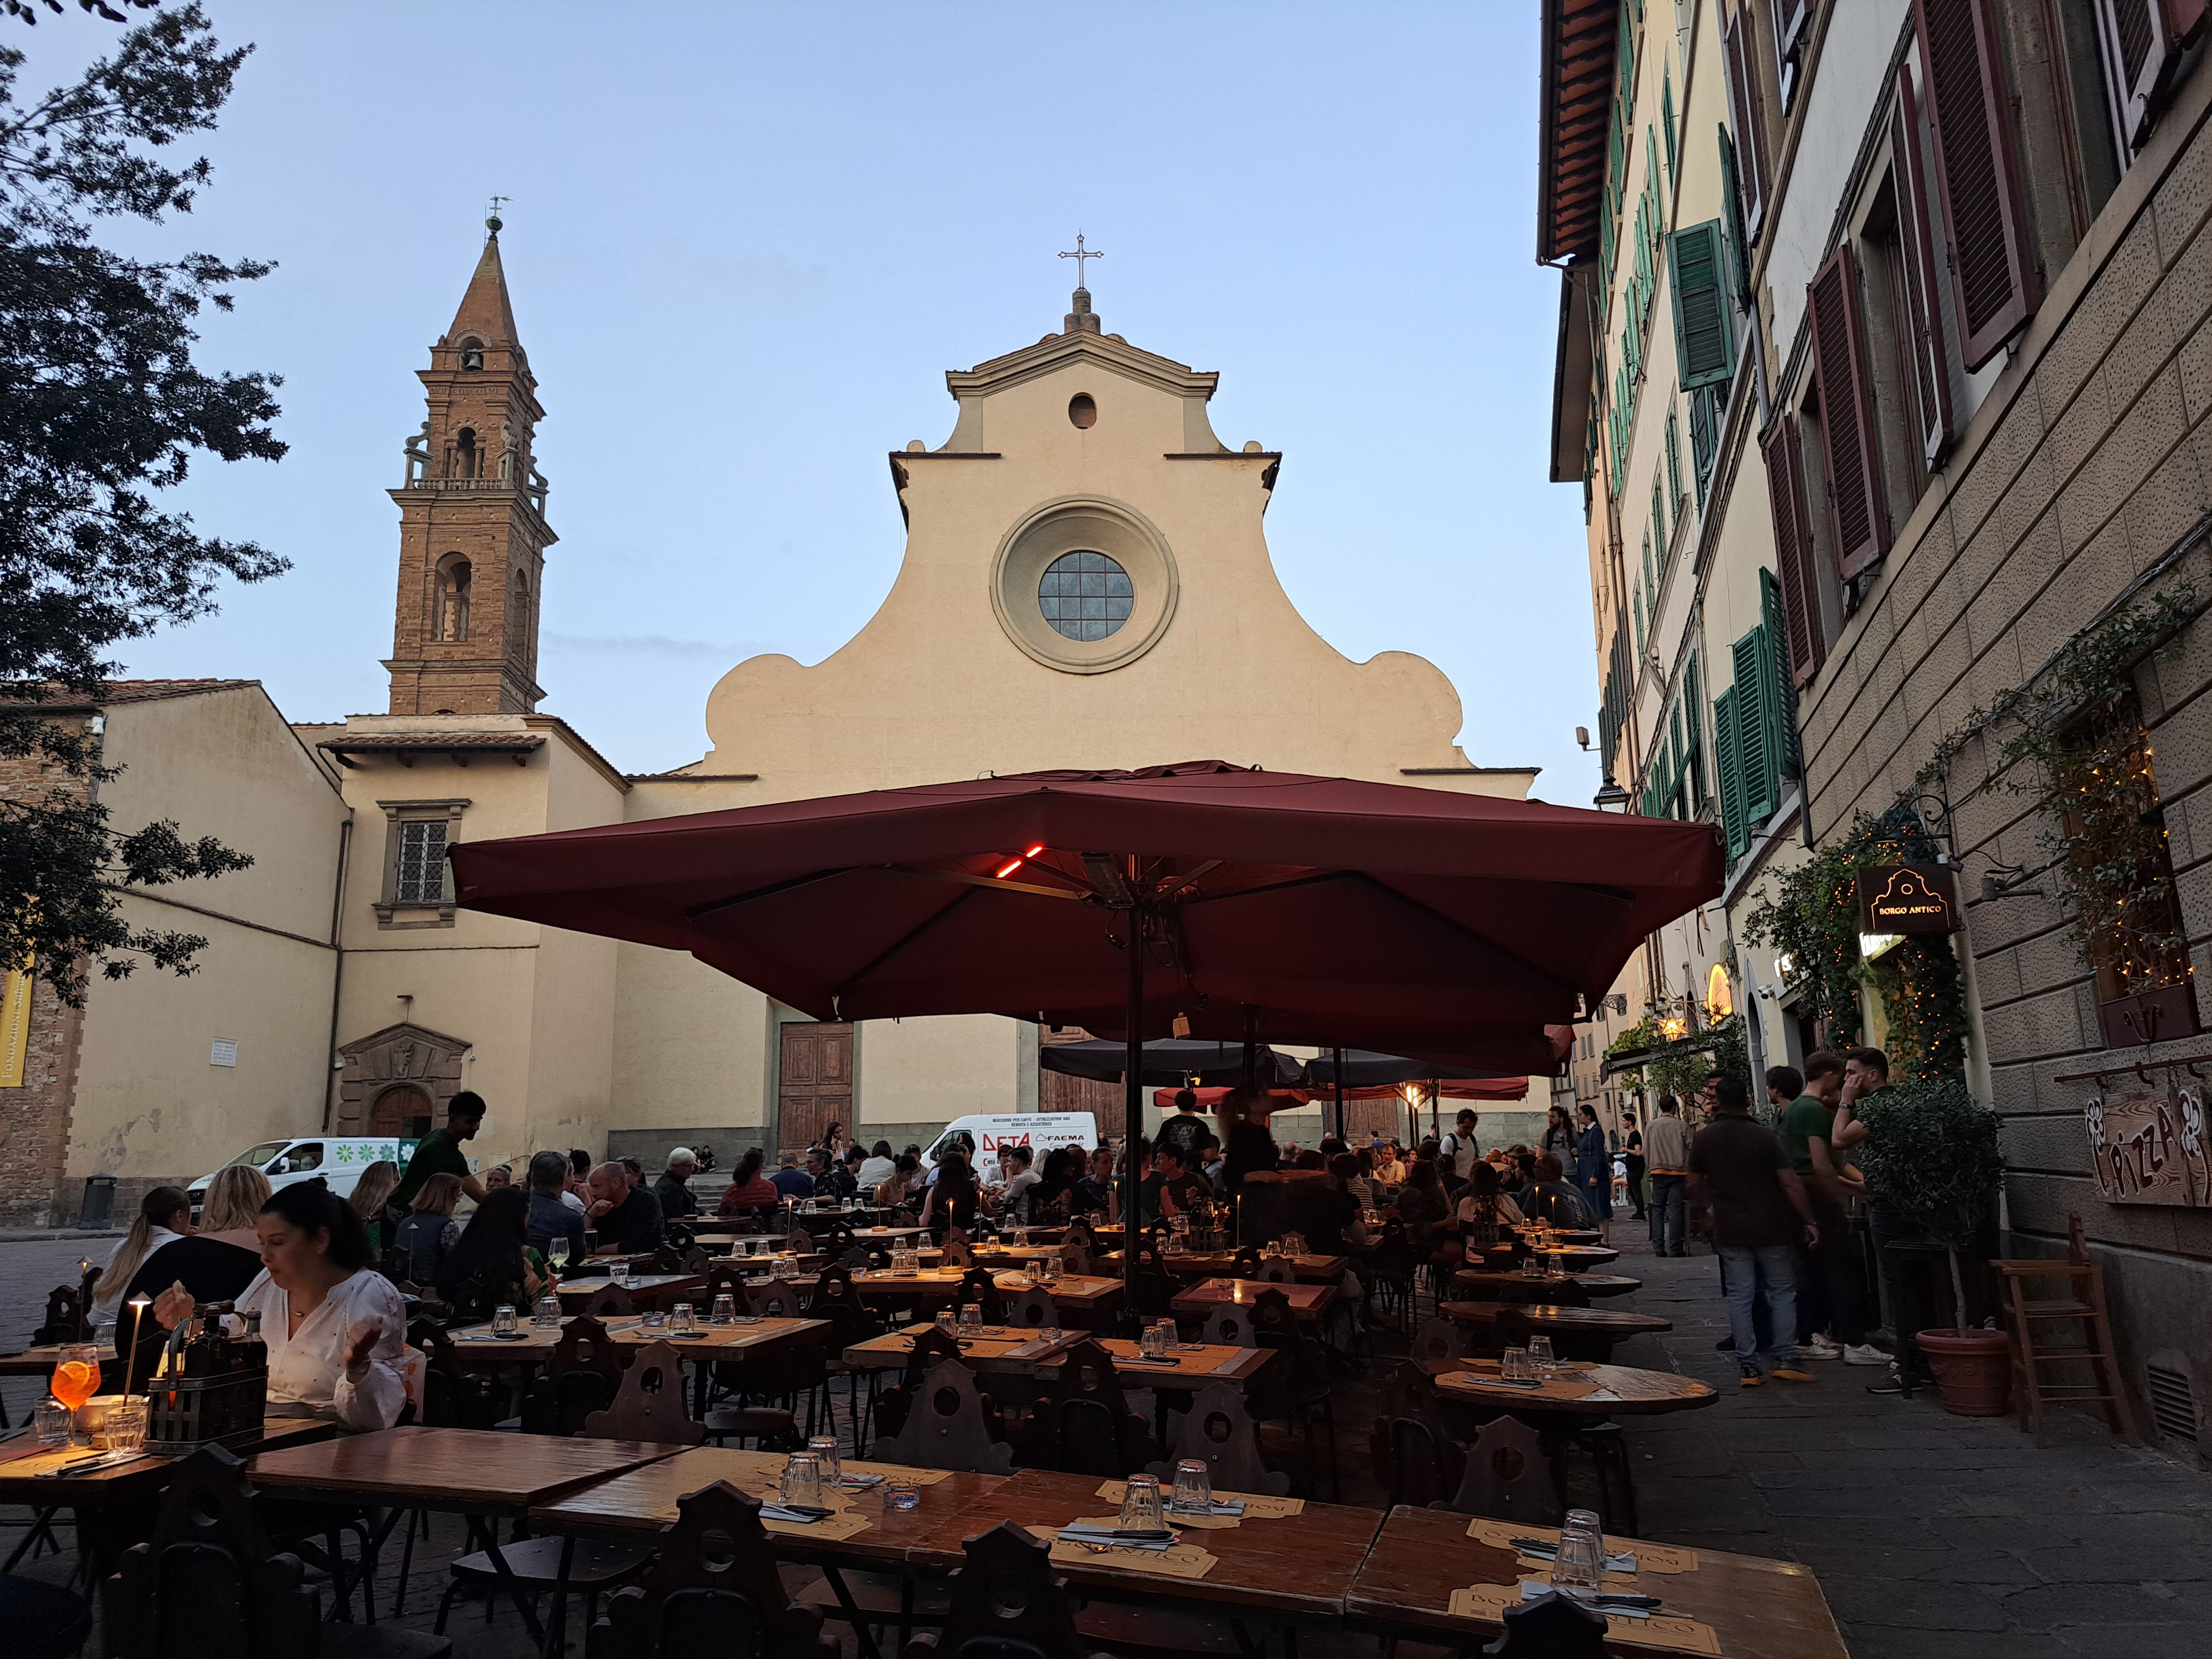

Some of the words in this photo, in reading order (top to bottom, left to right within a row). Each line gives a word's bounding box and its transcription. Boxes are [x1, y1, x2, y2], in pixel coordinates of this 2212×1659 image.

[1879, 907, 1907, 915] BORGO
[1909, 905, 1941, 914] ANTICO
[1471, 1594, 1522, 1608] BOR
